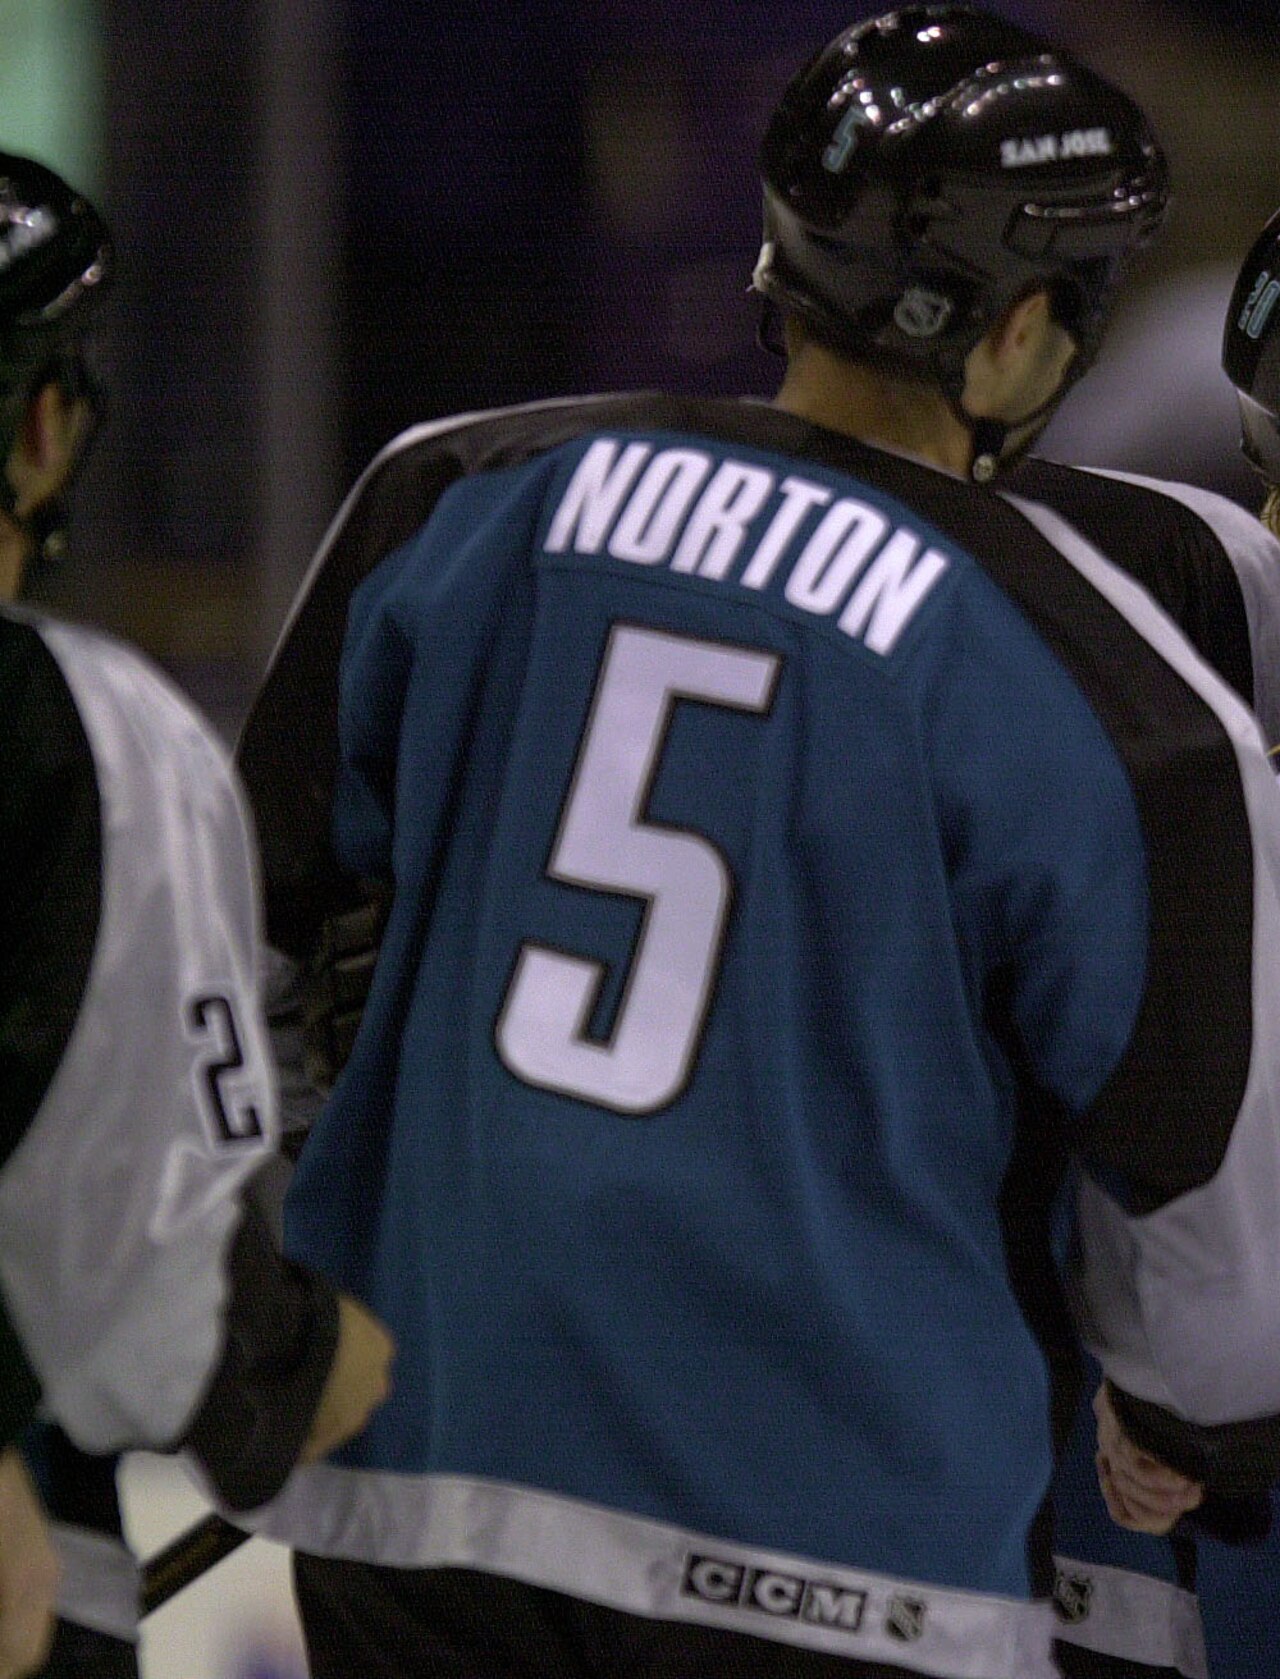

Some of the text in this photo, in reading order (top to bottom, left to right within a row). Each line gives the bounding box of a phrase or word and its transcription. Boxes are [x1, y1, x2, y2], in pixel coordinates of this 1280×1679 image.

[1000, 136, 1056, 168] SAN
[543, 438, 951, 657] NORTON
[494, 620, 783, 1118] 5
[189, 996, 264, 1141] 2
[686, 1557, 865, 1631] CCM
